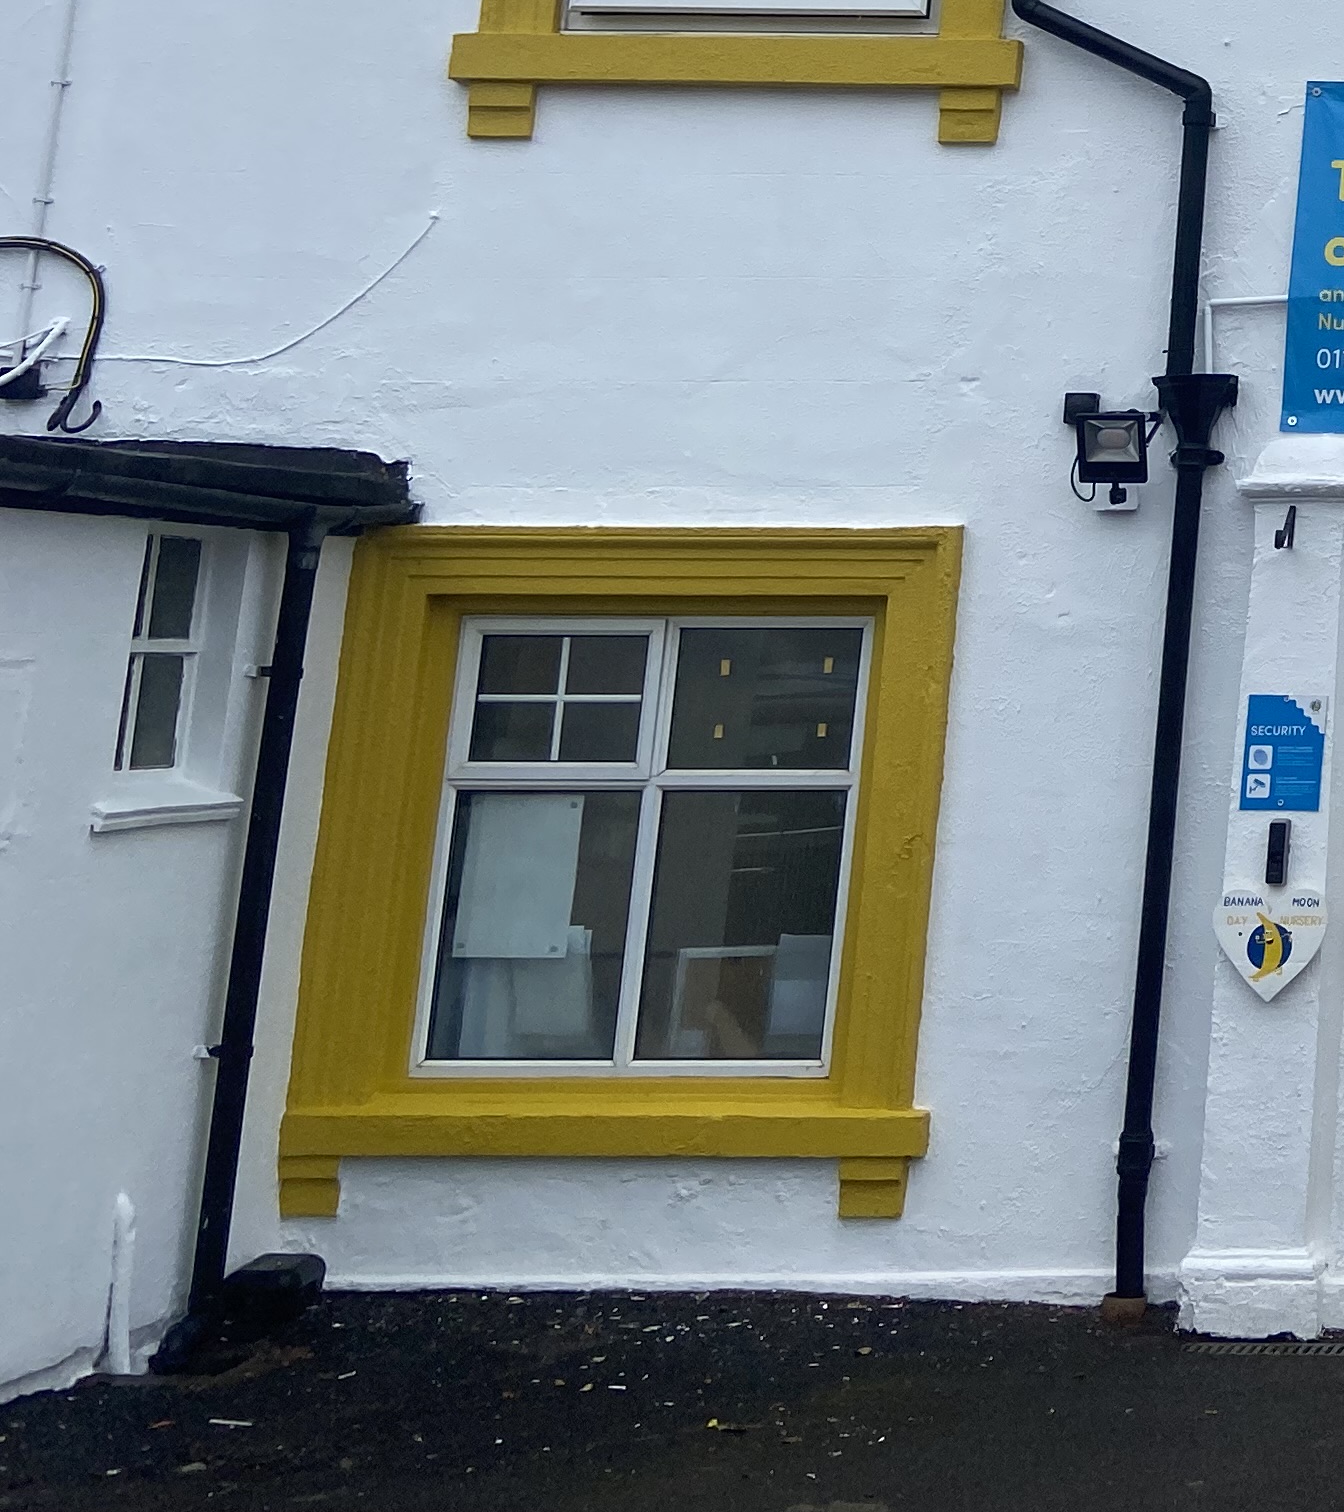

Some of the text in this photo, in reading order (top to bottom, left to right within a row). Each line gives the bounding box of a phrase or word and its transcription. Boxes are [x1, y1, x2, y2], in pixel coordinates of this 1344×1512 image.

[1251, 725, 1306, 736] SECURITY
[1224, 896, 1320, 907] BANANA MOON
